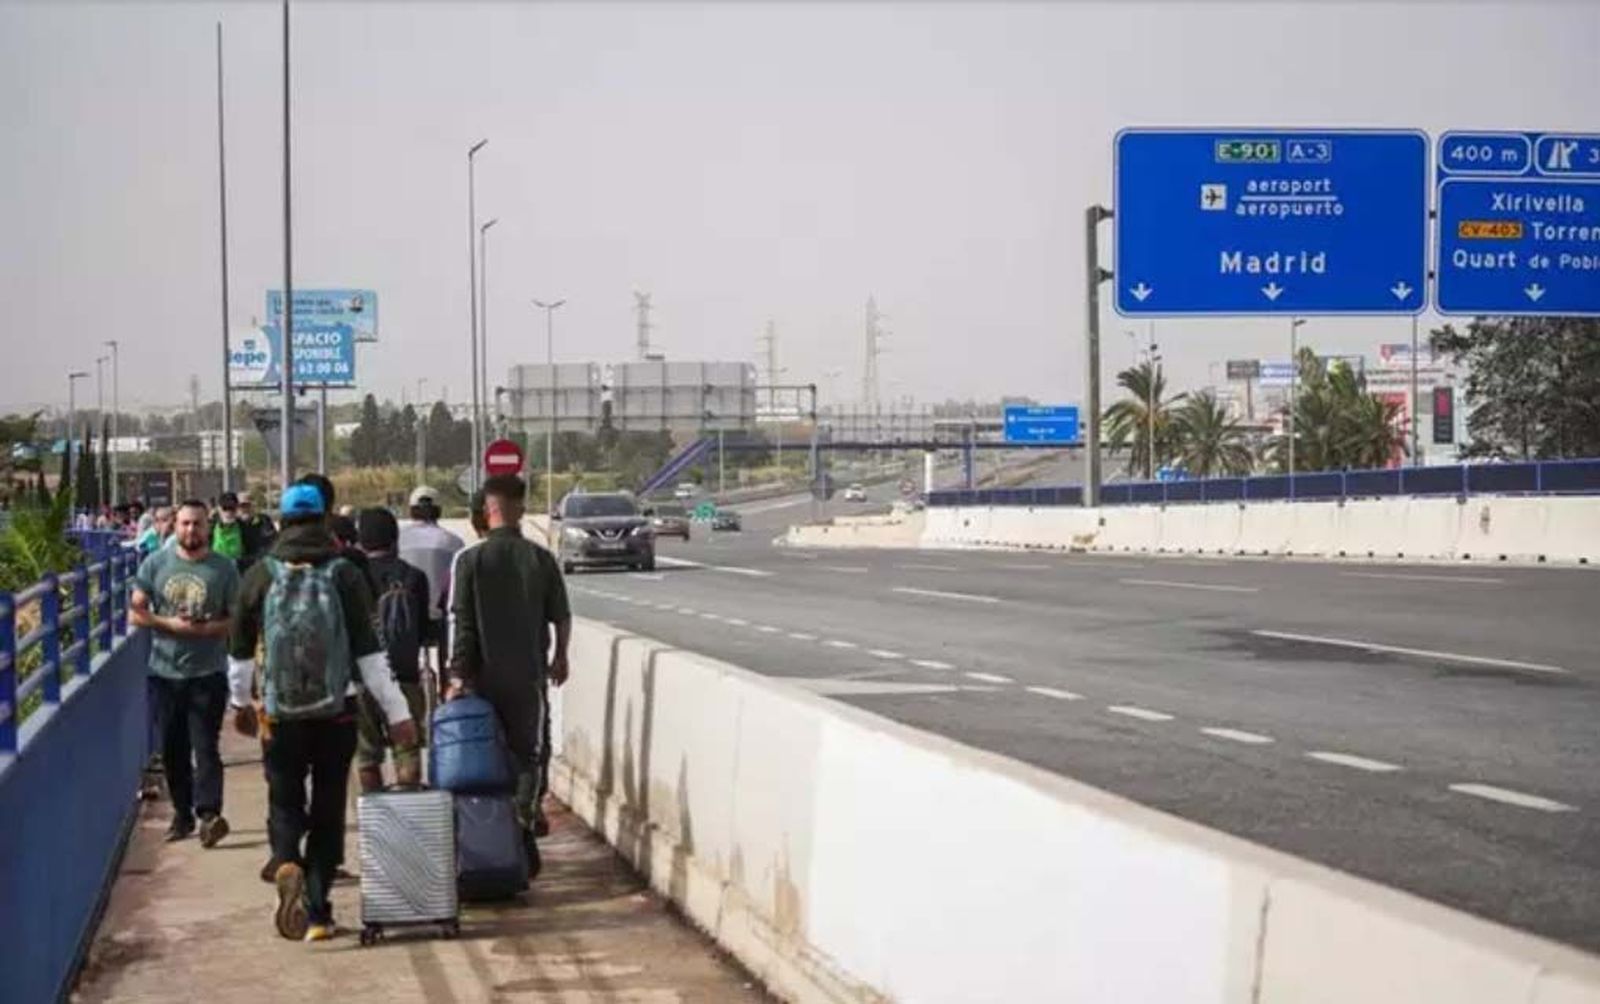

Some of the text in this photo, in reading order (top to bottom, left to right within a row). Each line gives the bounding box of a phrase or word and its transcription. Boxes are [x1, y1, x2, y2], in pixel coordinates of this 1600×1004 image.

[1218, 143, 1328, 159] E-901 A-3
[1451, 146, 1517, 162] 400 m
[1247, 178, 1331, 195] aeroport
[1235, 201, 1344, 219] aeropuerto
[1491, 192, 1584, 212] Xirivella
[1220, 250, 1326, 274] Madrid
[1452, 249, 1600, 270] Quart de Pobl
